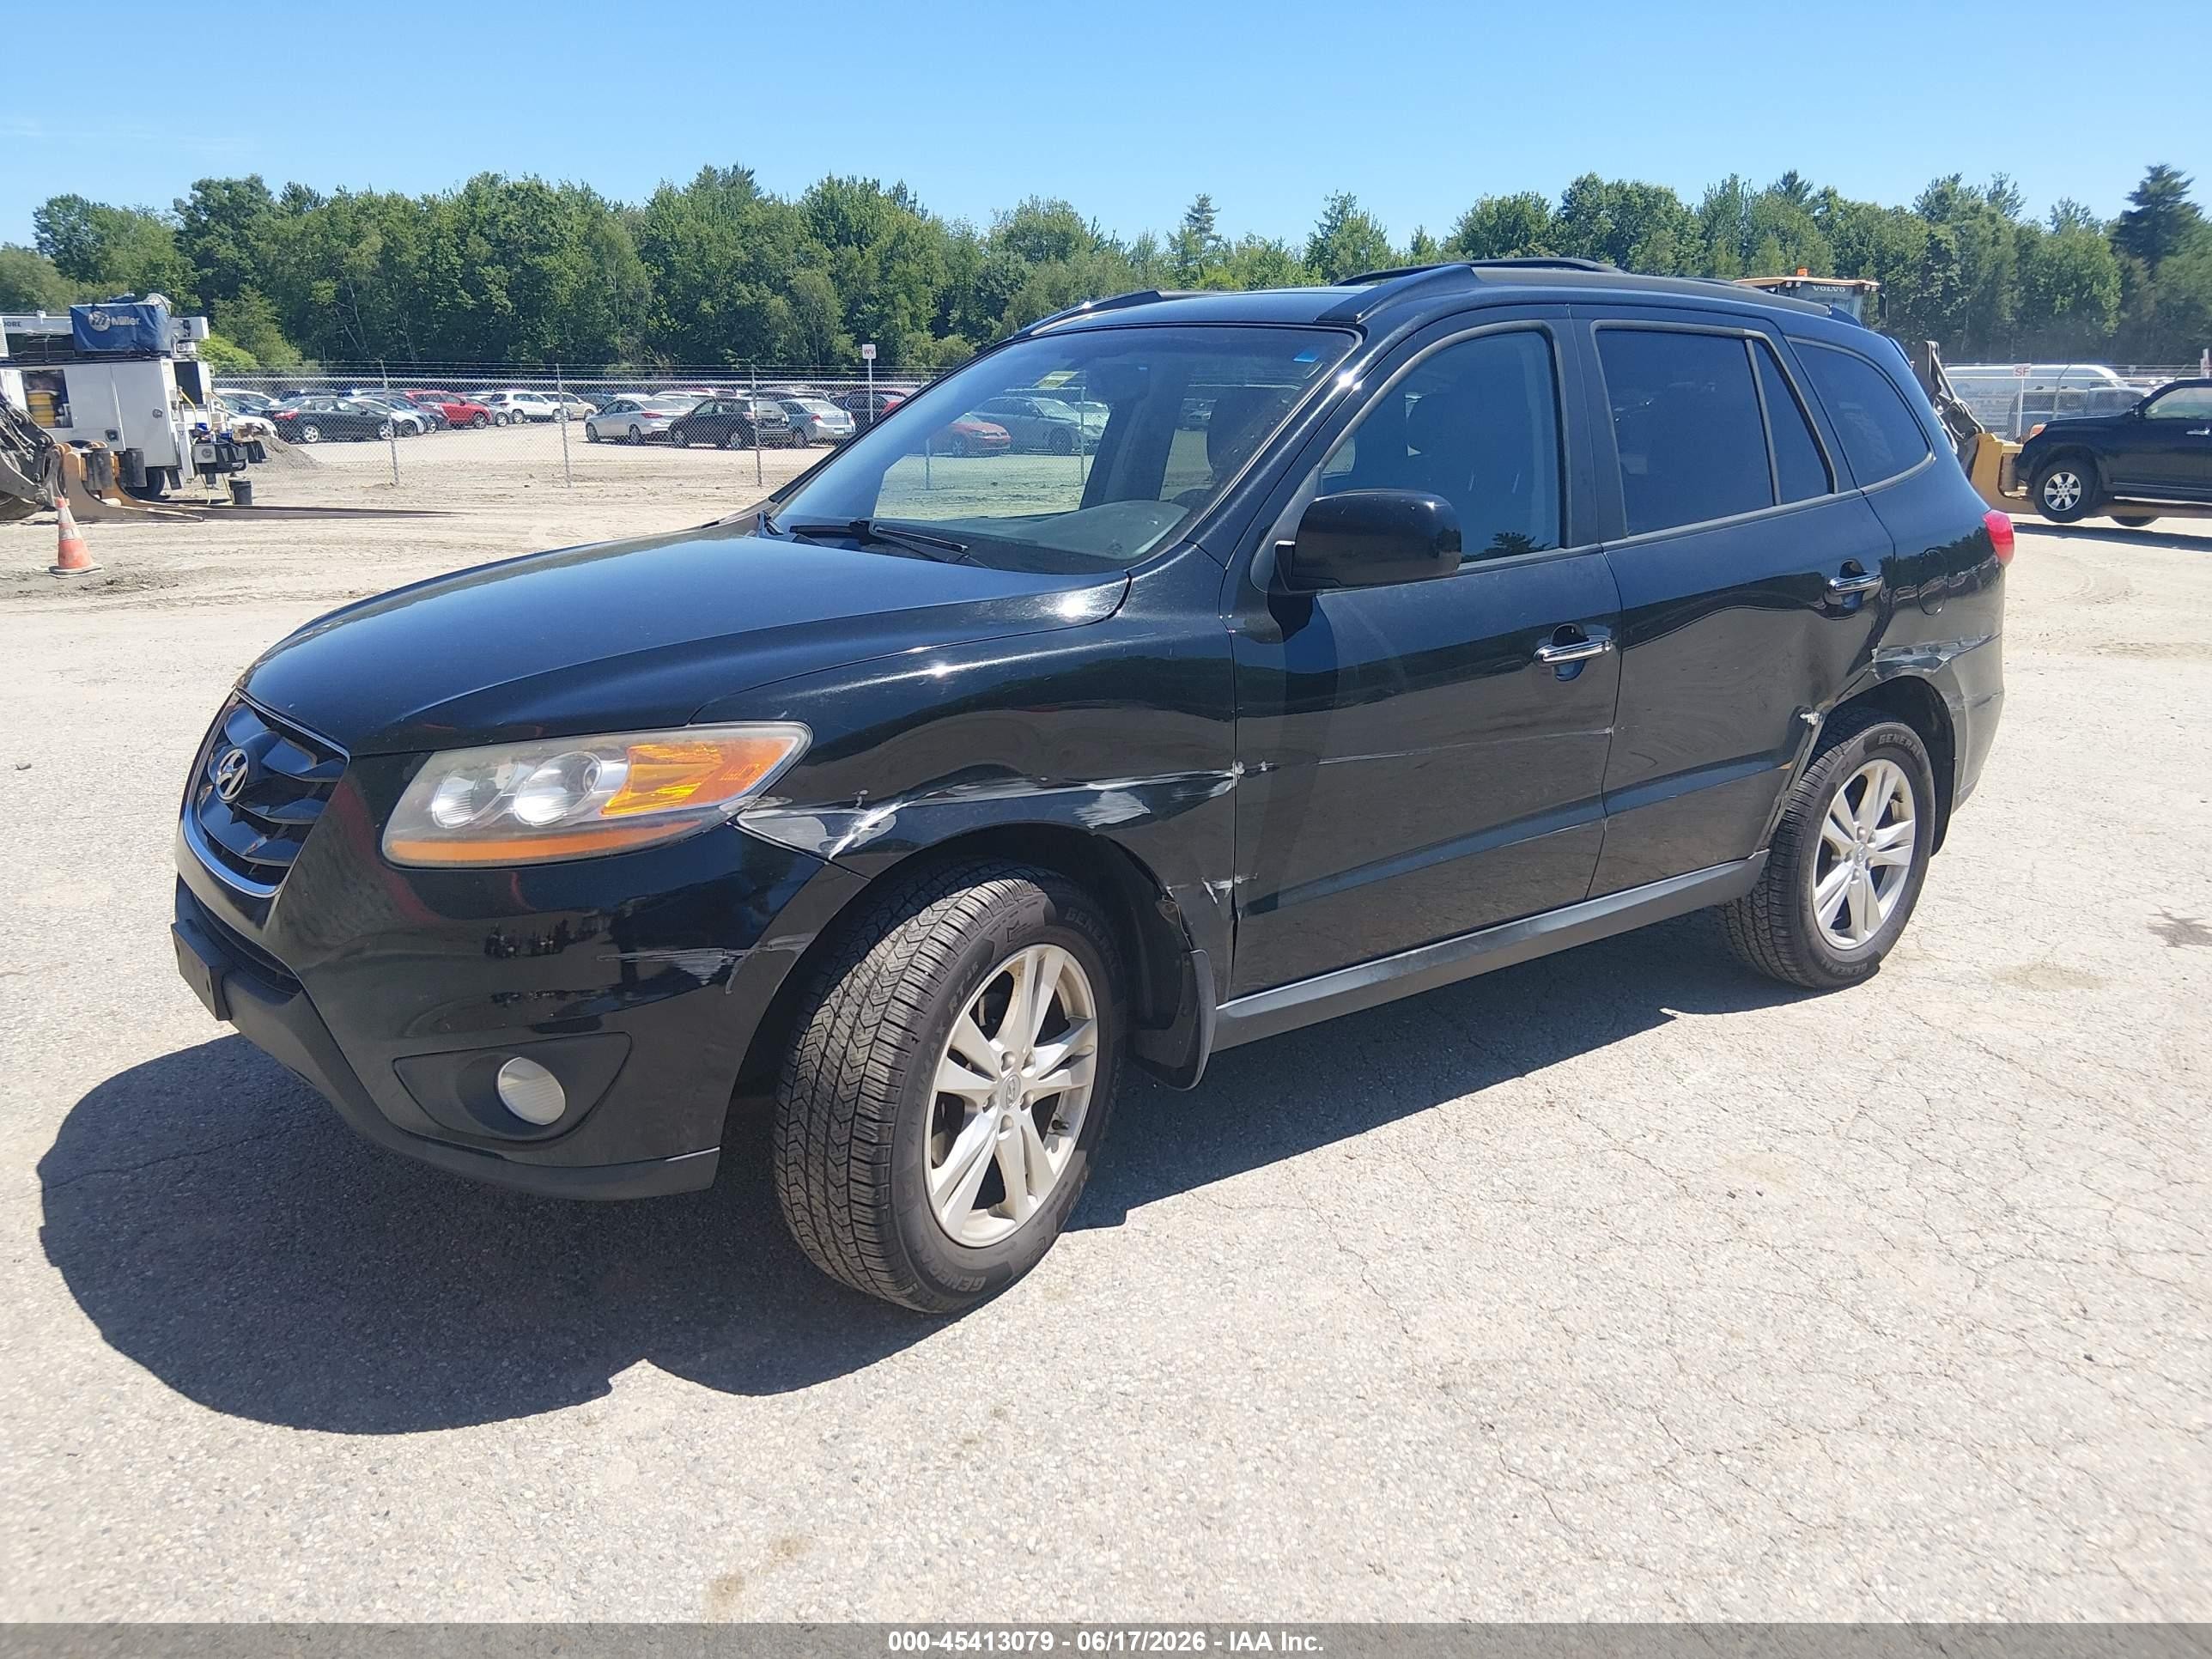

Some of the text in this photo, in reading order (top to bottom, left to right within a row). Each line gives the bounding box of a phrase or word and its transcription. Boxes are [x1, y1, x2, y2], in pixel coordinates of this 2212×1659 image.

[1813, 284, 1846, 293] VOLVO
[111, 316, 140, 326] Miller
[2014, 367, 2030, 377] SF
